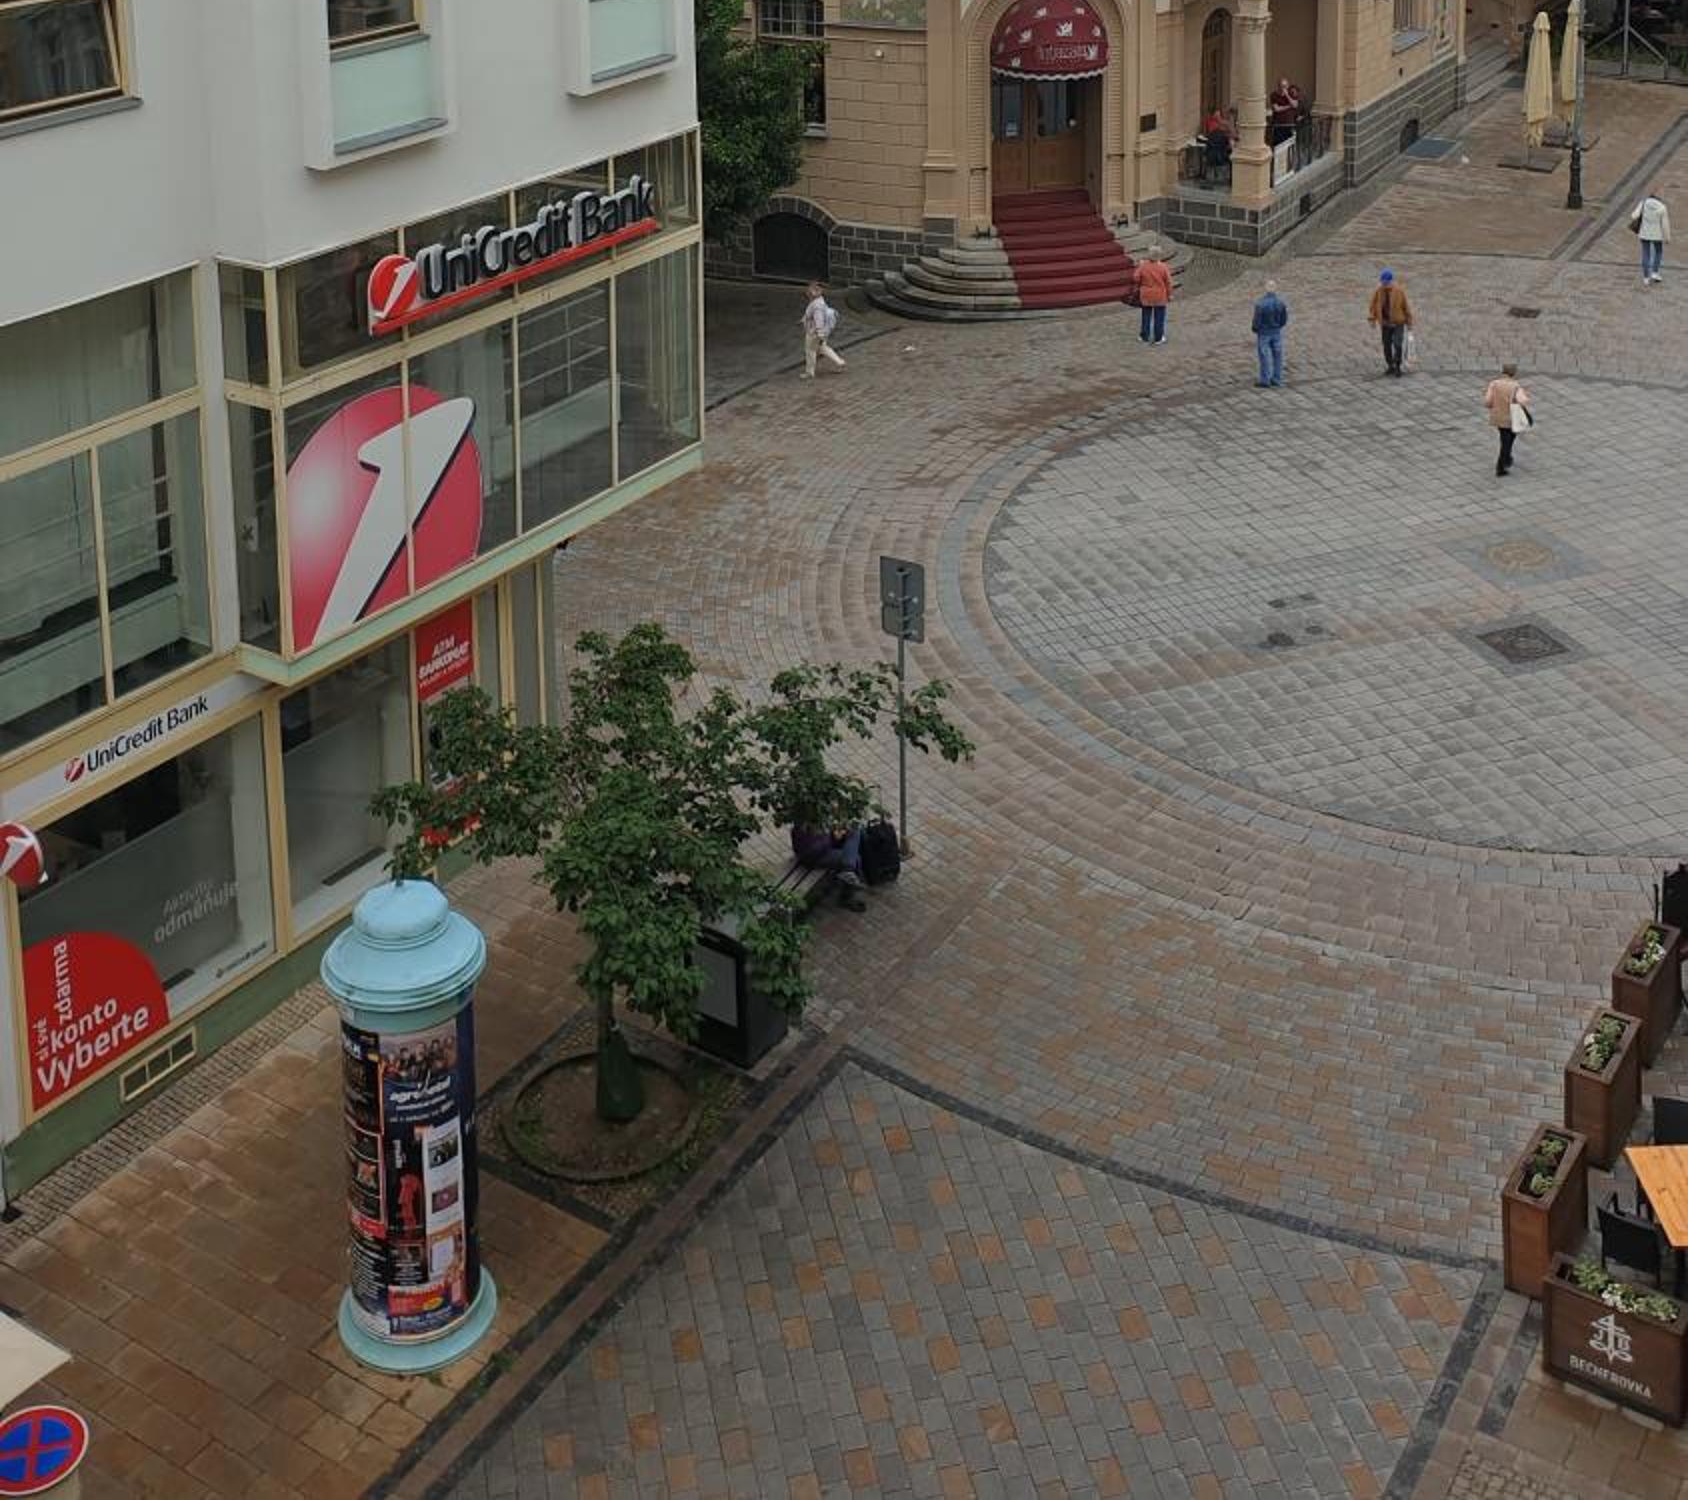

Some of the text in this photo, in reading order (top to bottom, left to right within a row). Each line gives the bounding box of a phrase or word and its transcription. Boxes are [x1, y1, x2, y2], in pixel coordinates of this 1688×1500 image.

[417, 174, 655, 299] UniCredit Bank
[87, 695, 208, 771] UniCredit Bank
[53, 940, 73, 1025] zdarma
[37, 1006, 149, 1092] Vyberte
[51, 998, 118, 1053] konto
[1569, 1354, 1653, 1399] BECHEROVKA
